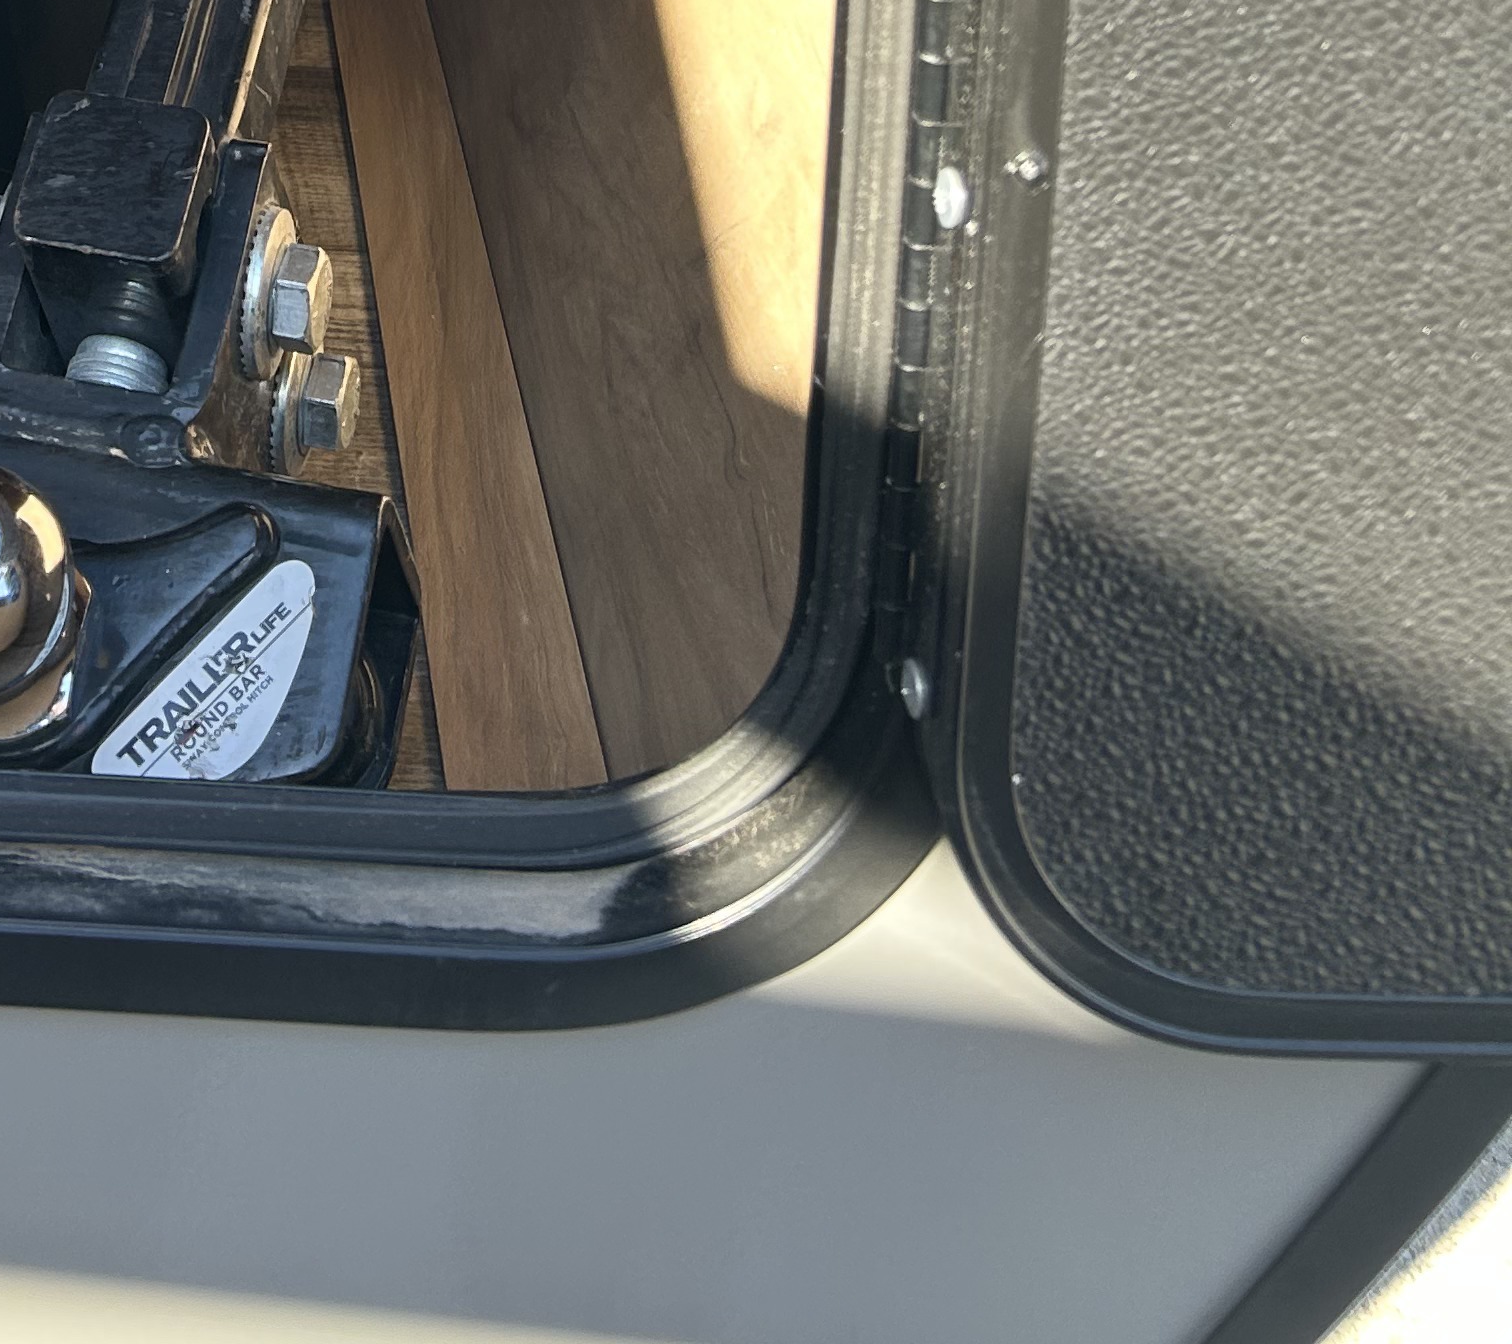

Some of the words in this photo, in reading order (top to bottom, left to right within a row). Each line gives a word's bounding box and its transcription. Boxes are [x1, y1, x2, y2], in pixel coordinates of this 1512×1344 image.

[249, 601, 293, 646] LIFE
[228, 663, 266, 701] BAR
[246, 674, 275, 702] HITCH
